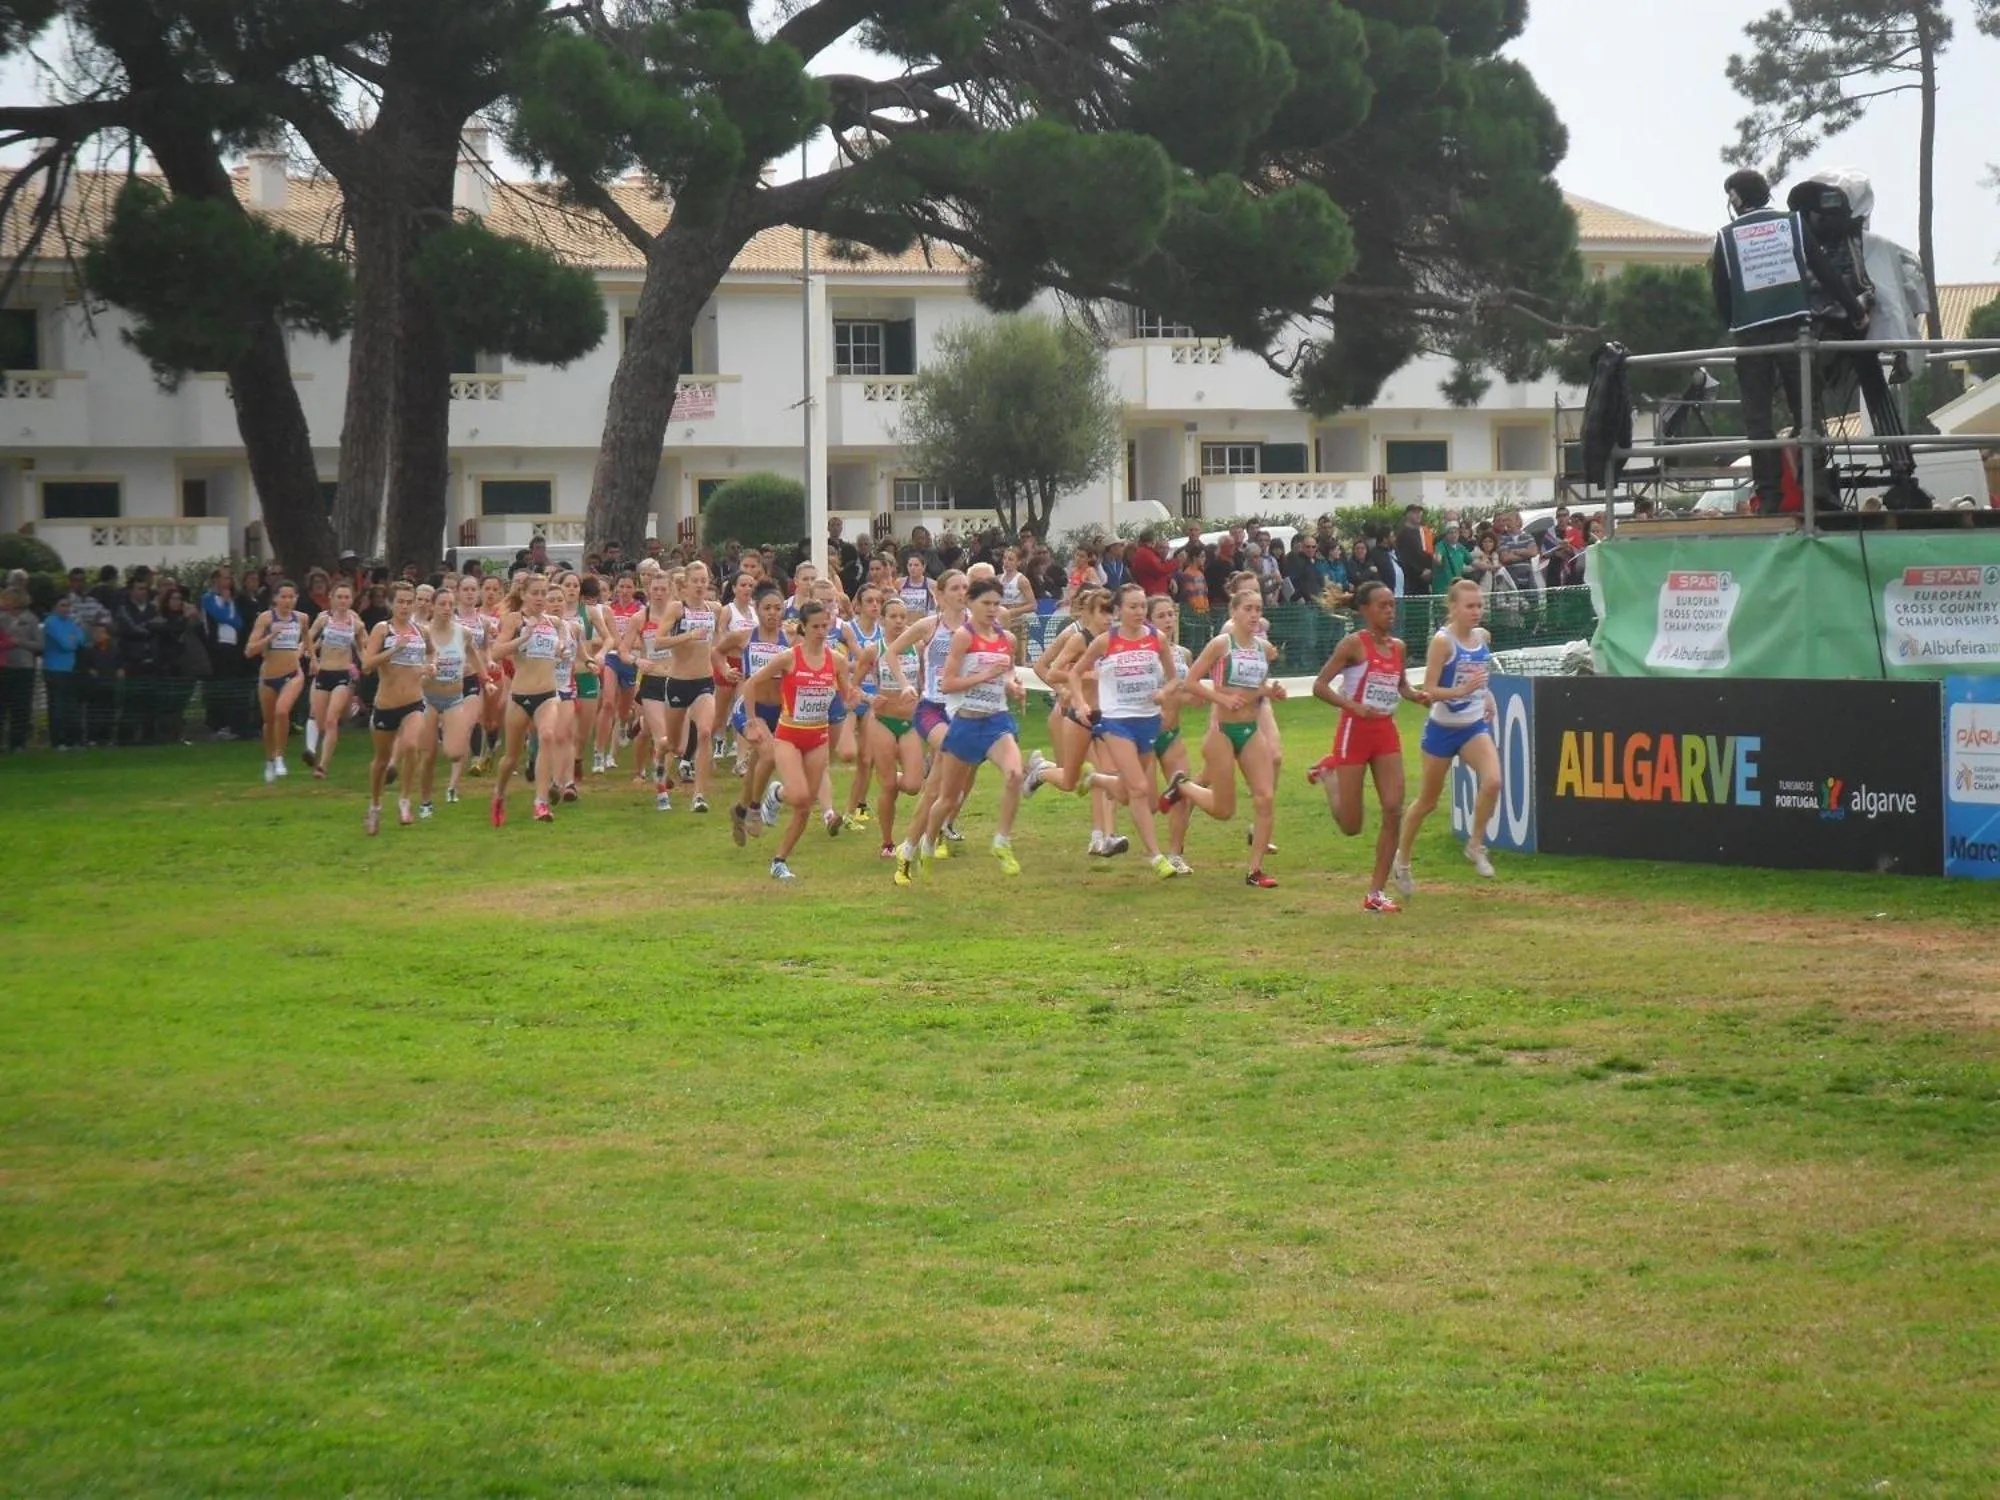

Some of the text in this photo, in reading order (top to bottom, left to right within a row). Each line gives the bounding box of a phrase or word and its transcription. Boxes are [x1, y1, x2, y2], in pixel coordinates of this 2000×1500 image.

[1678, 575, 1718, 588] SPAR
[1921, 568, 1980, 584] SPAR
[1675, 596, 1720, 606] EUROPEAN
[1914, 590, 1982, 601] EUROPEAN
[1664, 609, 1690, 619] CROSS
[1894, 601, 1999, 614] CROSS COUNTRY
[1897, 614, 2000, 627] CHAMPIONSHIPS
[1556, 730, 1761, 807] ALLGARVE
[1775, 795, 1820, 809] PORTUGAL
[1851, 784, 1917, 819] algarve
